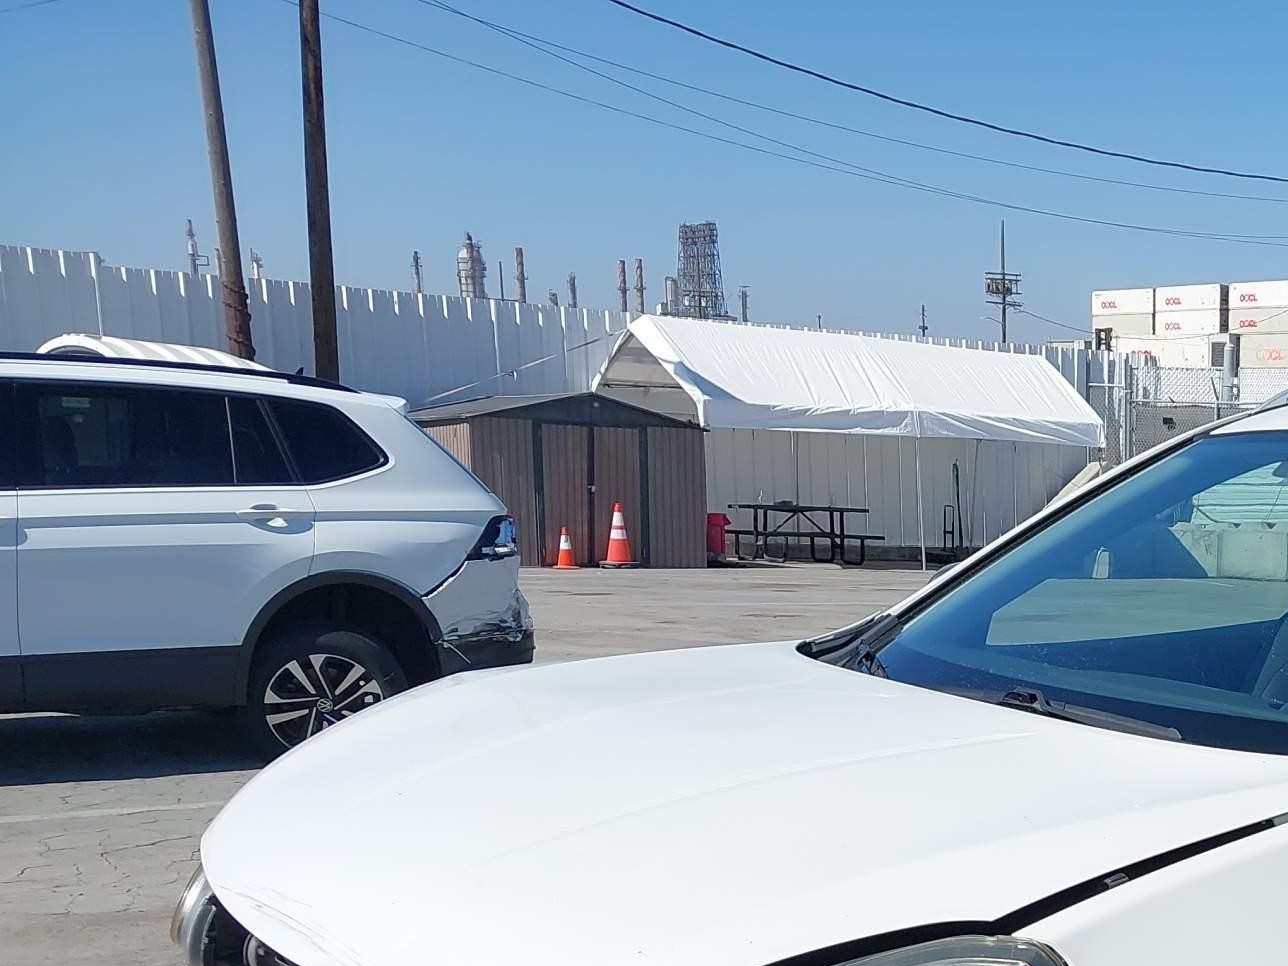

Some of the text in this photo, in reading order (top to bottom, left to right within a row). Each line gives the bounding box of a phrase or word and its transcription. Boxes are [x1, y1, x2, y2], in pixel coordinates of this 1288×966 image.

[1101, 301, 1118, 309] OOCL
[1165, 297, 1182, 306] OOCL
[1165, 322, 1182, 331] OOCL
